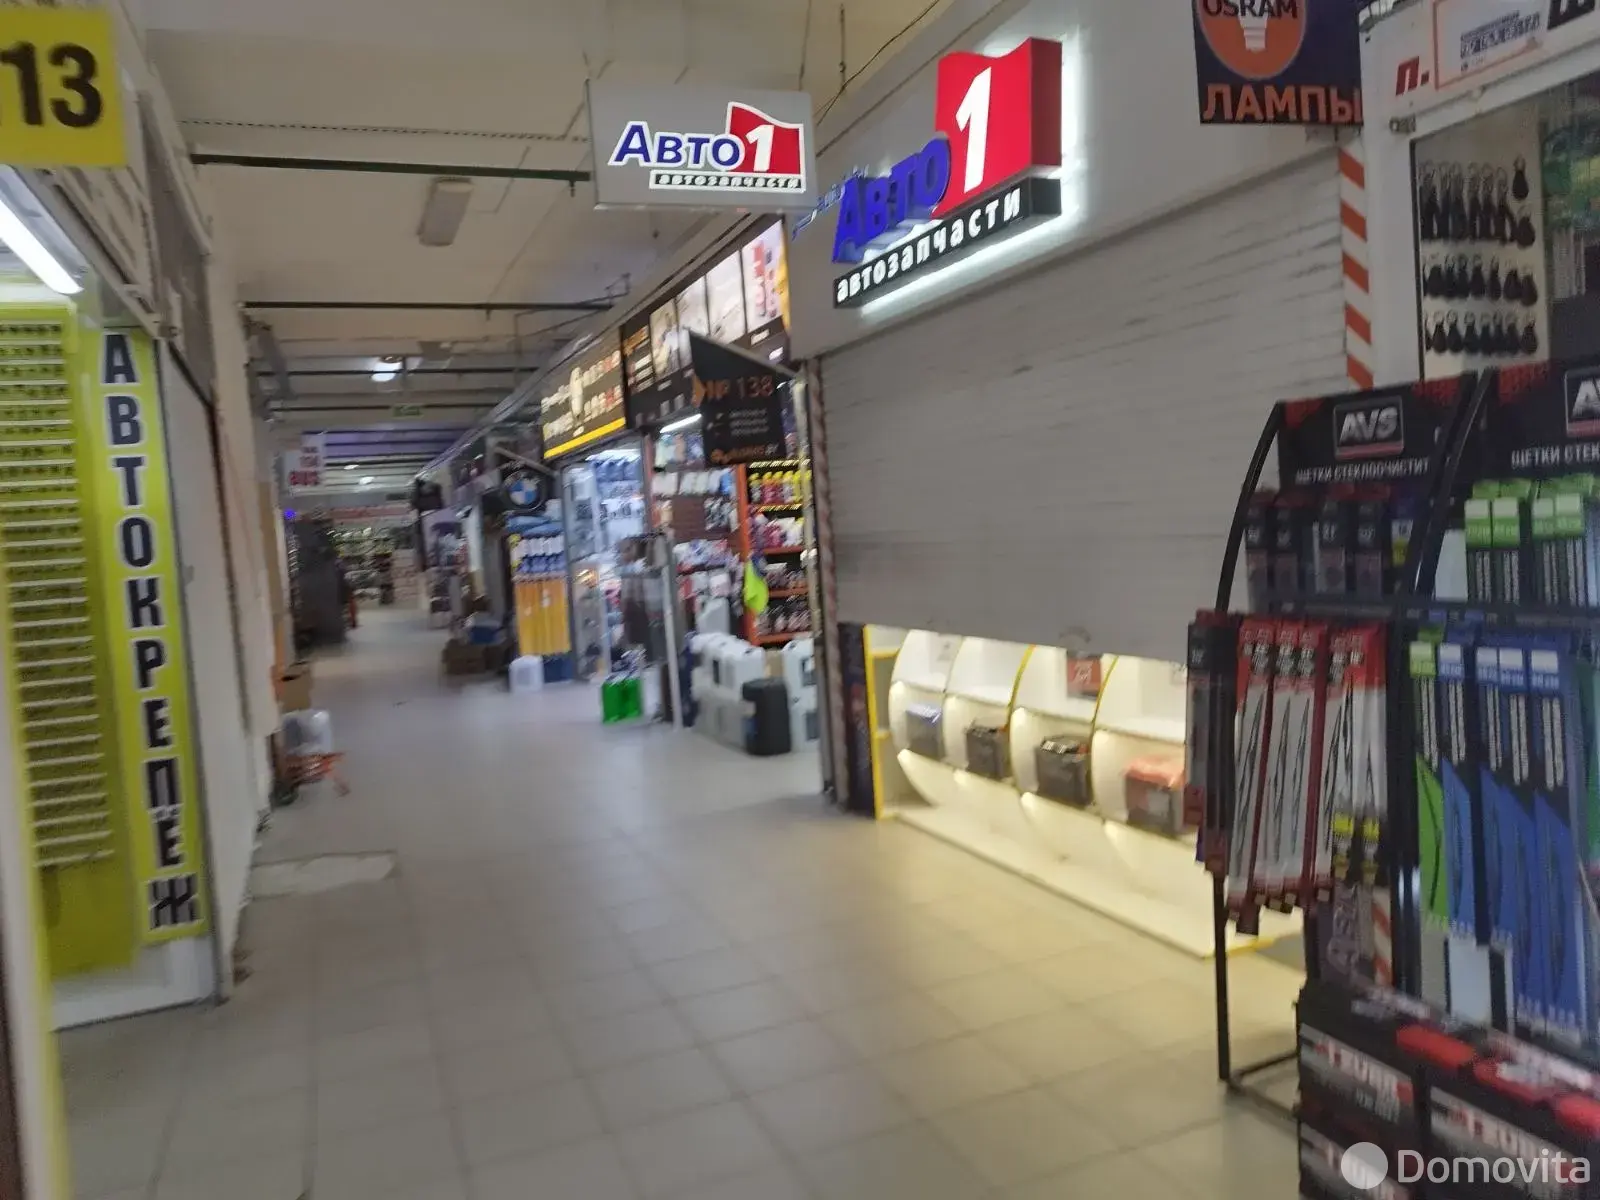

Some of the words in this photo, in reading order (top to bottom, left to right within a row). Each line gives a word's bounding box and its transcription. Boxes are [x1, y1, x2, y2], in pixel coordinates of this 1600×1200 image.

[1203, 0, 1299, 18] OSRAM
[1203, 84, 1363, 124] ЛАМПЫ
[836, 188, 1023, 303] автозапчасти
[1339, 405, 1399, 445] AVS
